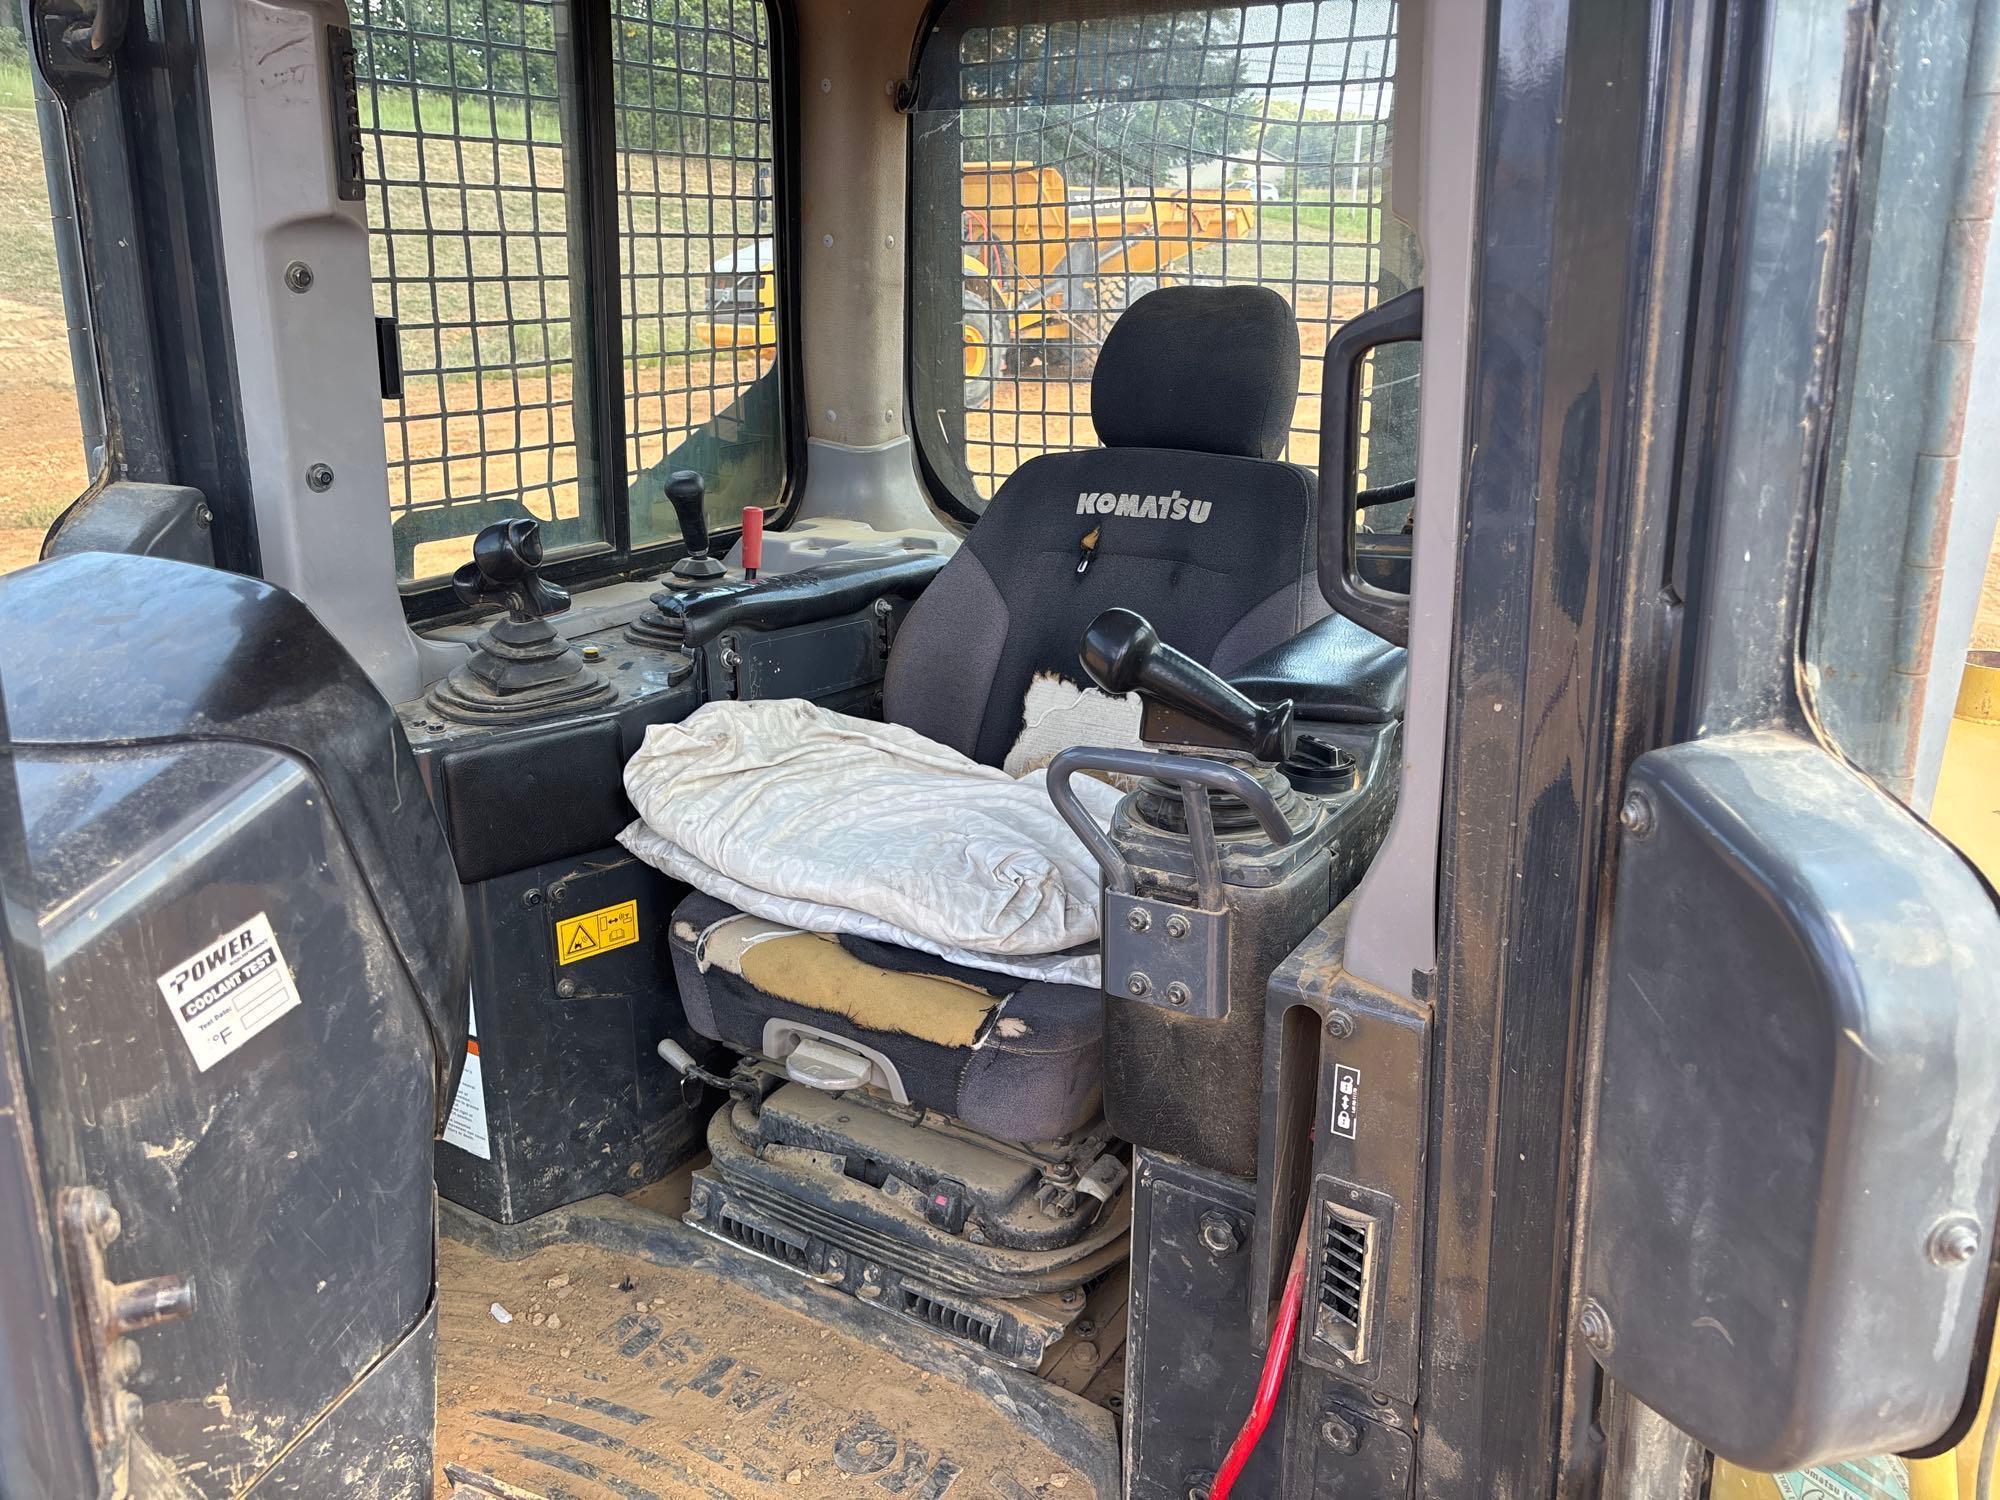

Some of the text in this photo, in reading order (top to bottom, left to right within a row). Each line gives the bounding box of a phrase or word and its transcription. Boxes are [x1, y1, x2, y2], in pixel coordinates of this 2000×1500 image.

[1076, 490, 1212, 523] KOMATSU
[170, 929, 253, 994] POWER
[185, 953, 272, 1016] COOLANT TEST
